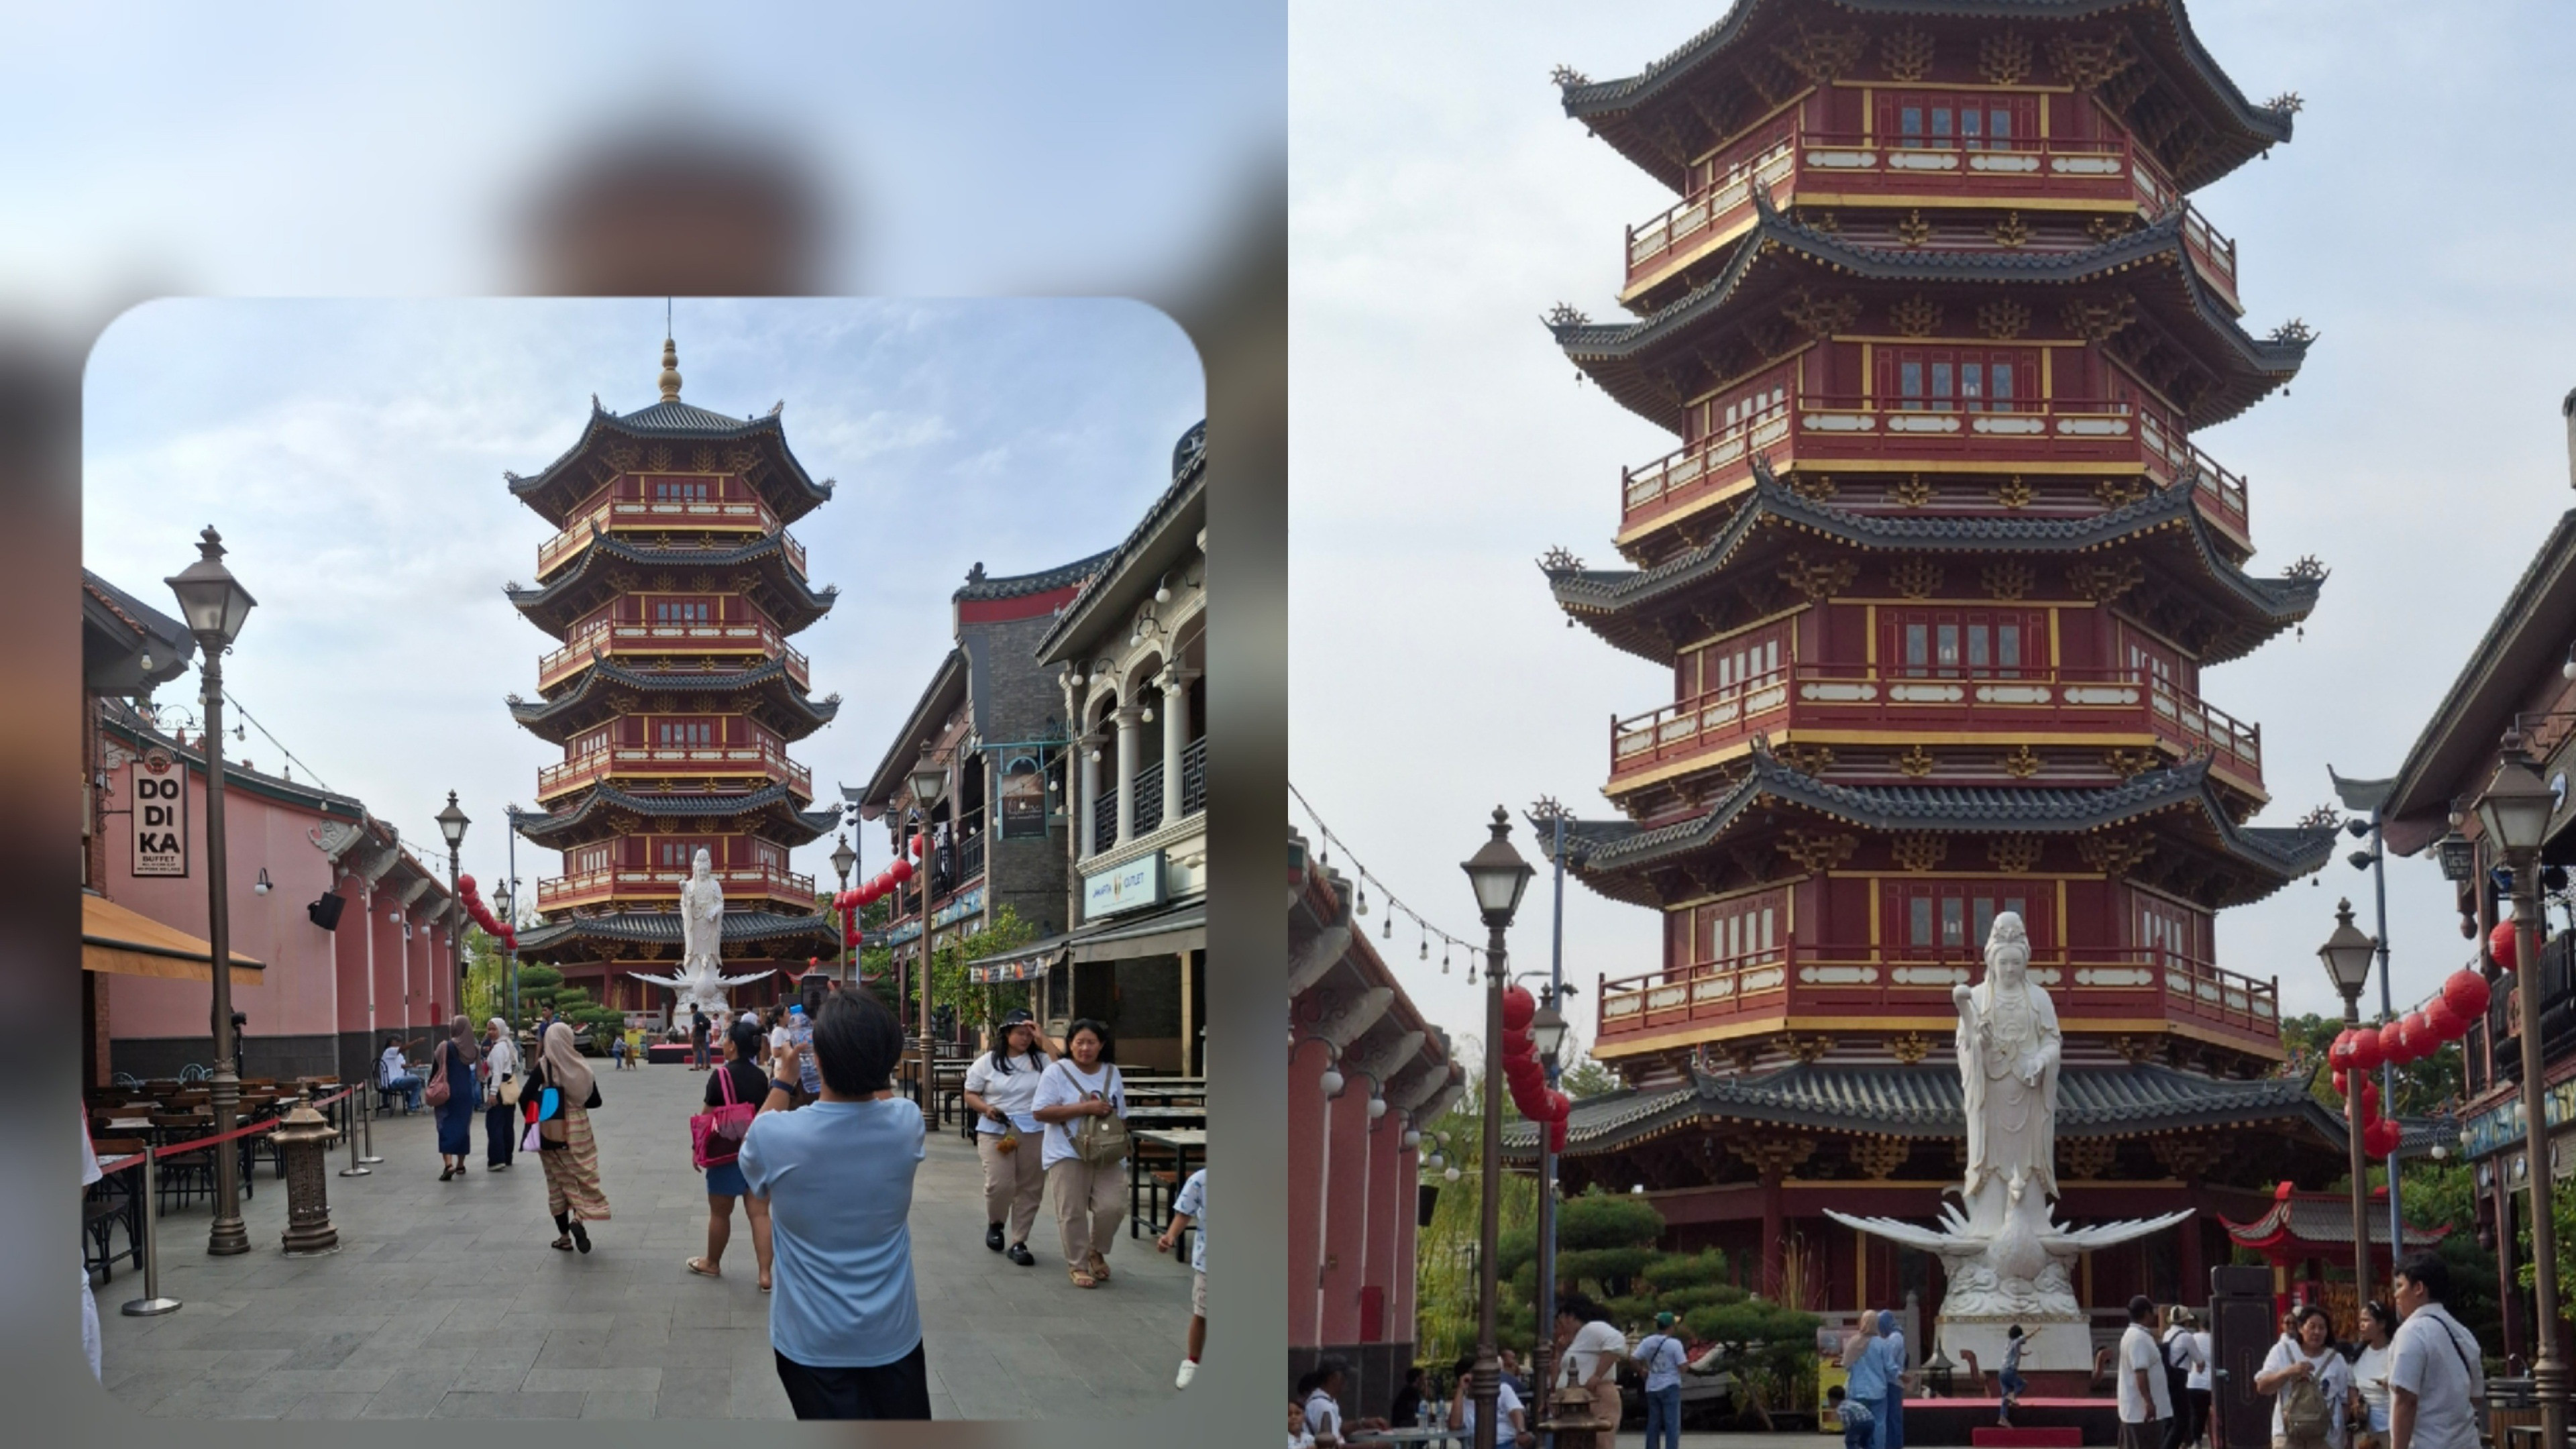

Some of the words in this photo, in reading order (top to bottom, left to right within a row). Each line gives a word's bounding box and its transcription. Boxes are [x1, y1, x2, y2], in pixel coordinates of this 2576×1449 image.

[138, 779, 178, 800] DO
[145, 806, 173, 826] DI
[140, 833, 180, 854] KA
